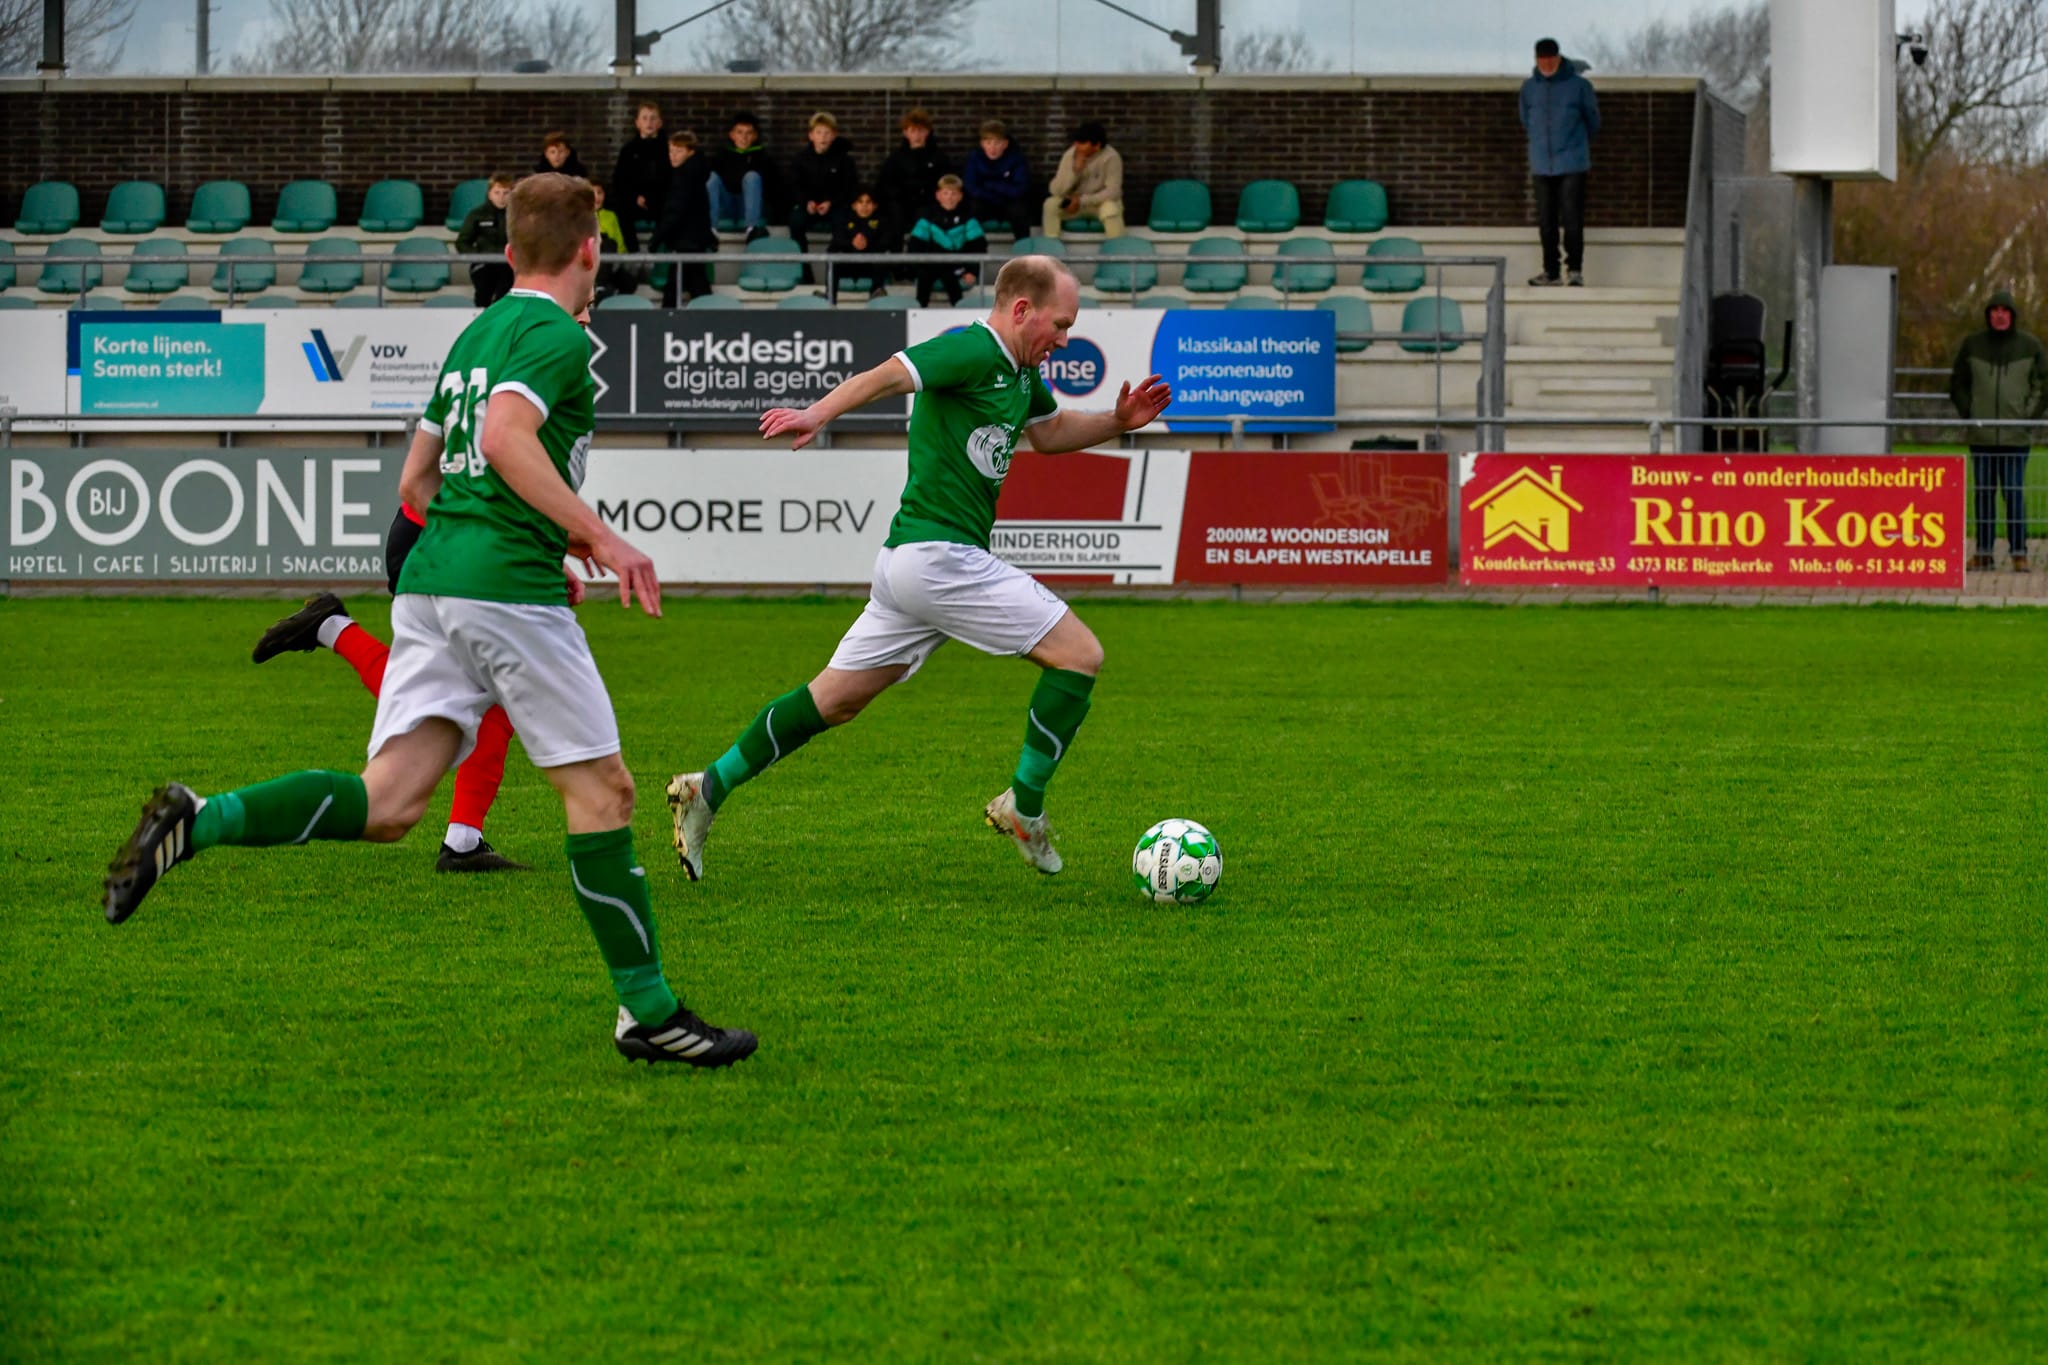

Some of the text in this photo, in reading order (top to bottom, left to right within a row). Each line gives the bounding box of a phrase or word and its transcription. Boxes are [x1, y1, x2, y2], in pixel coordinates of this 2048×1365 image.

[94, 335, 212, 359] Korte lijnen.
[370, 345, 408, 359] VDV
[664, 331, 854, 370] brkdesign
[1178, 336, 1321, 354] klassikaal theorie
[94, 358, 222, 377] Samen sterk!
[1039, 360, 1096, 380] anse
[1178, 362, 1294, 381] personenauto
[370, 373, 438, 385] Belastingadvi
[664, 365, 747, 395] digital
[1178, 386, 1304, 407] aanhangwagen
[1711, 469, 1737, 486] en
[1743, 466, 1946, 492] onderhoudsbedrijf
[10, 459, 381, 546] BOONE
[90, 487, 126, 516] BIJ
[597, 499, 875, 533] MOORE DRV
[1630, 496, 1946, 548] Rino Koets
[1206, 527, 1389, 544] 2000M2 WOONDESIGN
[10, 555, 382, 573] HOTEL CAFE SLIJTERIJ SNACKBAR
[992, 552, 1120, 562] ONDESIGN EN SLAPEN
[1206, 549, 1432, 565] EN SLAPEN WESTKAPELLE
[1473, 556, 1595, 575] Koudekerkseweg
[1598, 557, 1616, 572] 33
[1627, 557, 1661, 572] 4373
[1665, 557, 1688, 572] RE
[1692, 557, 1773, 576] Biggekerke
[1789, 558, 1832, 573] Mob.:
[1835, 558, 1853, 573] 06
[1866, 559, 1882, 573] 51
[1886, 559, 1905, 573] 34
[1907, 559, 1926, 573] 49
[1928, 559, 1947, 573] 58
